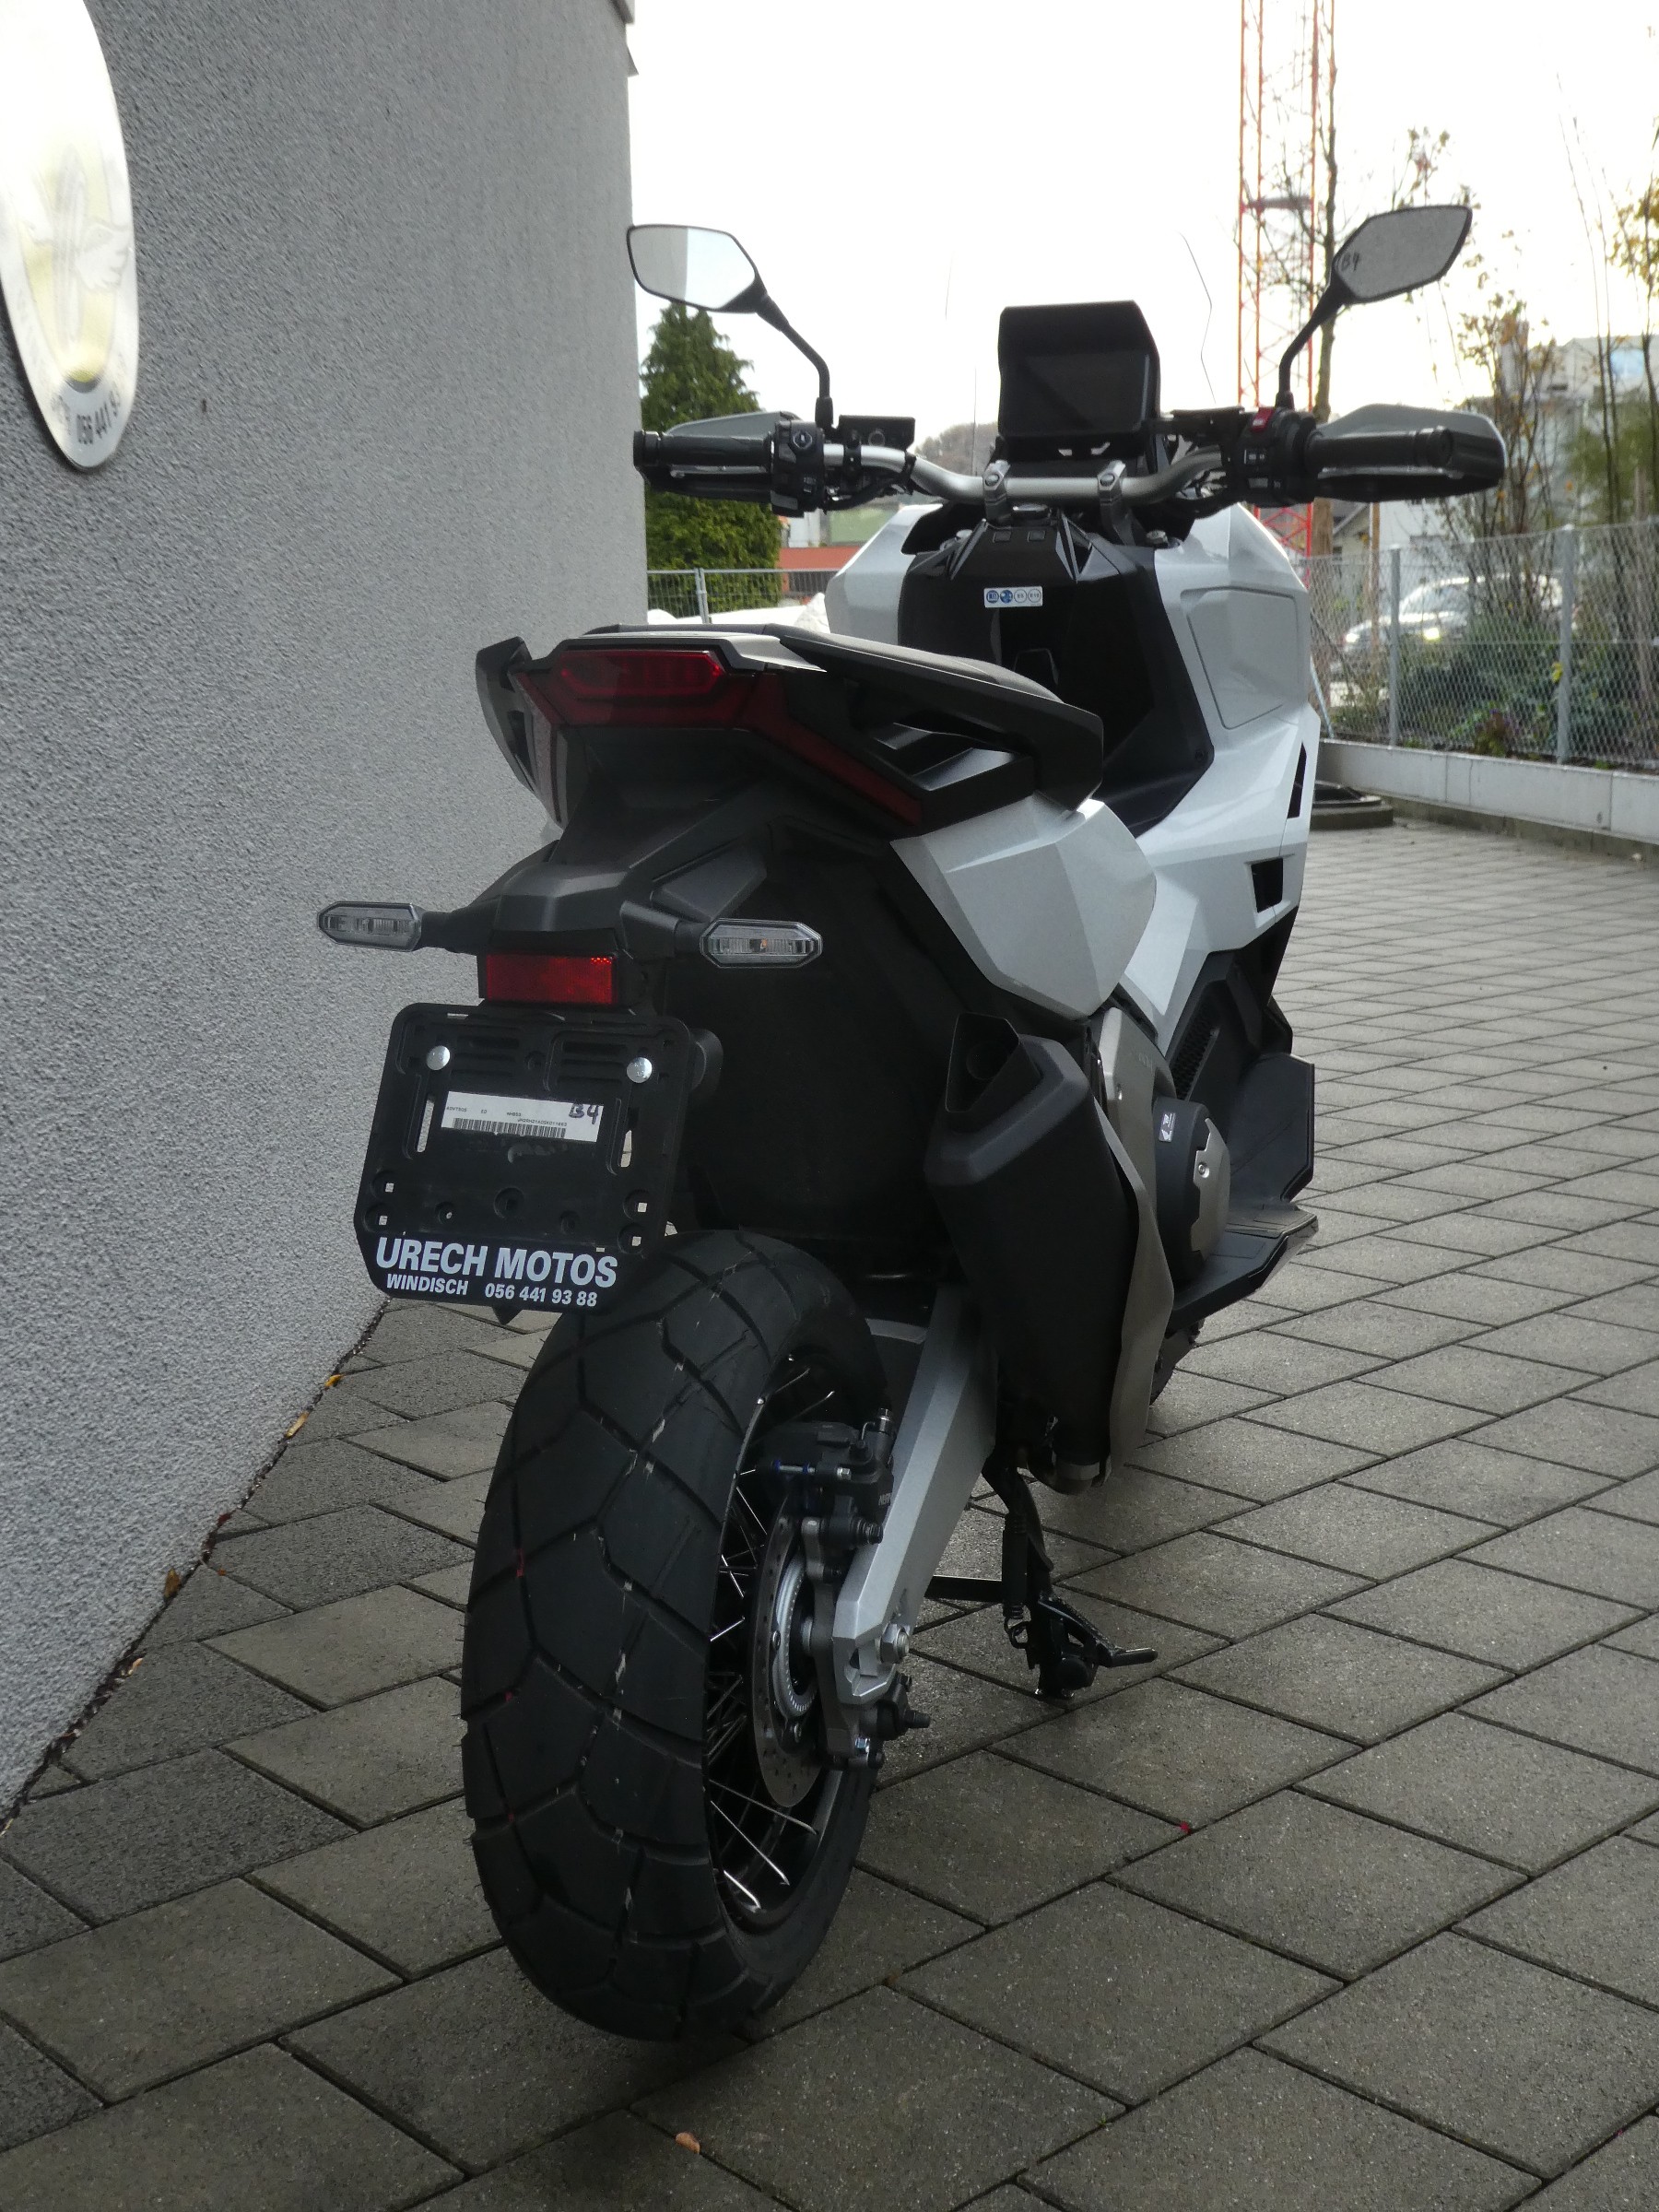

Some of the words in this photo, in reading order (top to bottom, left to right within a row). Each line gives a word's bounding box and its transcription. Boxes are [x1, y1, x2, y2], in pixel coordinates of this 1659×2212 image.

[569, 1102, 599, 1124] B4
[376, 1236, 488, 1277] URECH
[494, 1247, 618, 1288] MOTOS
[387, 1273, 469, 1296] WINDISCH
[485, 1282, 515, 1300] 056
[519, 1286, 547, 1302] 441
[551, 1288, 572, 1305] 93
[576, 1290, 598, 1307] 88
